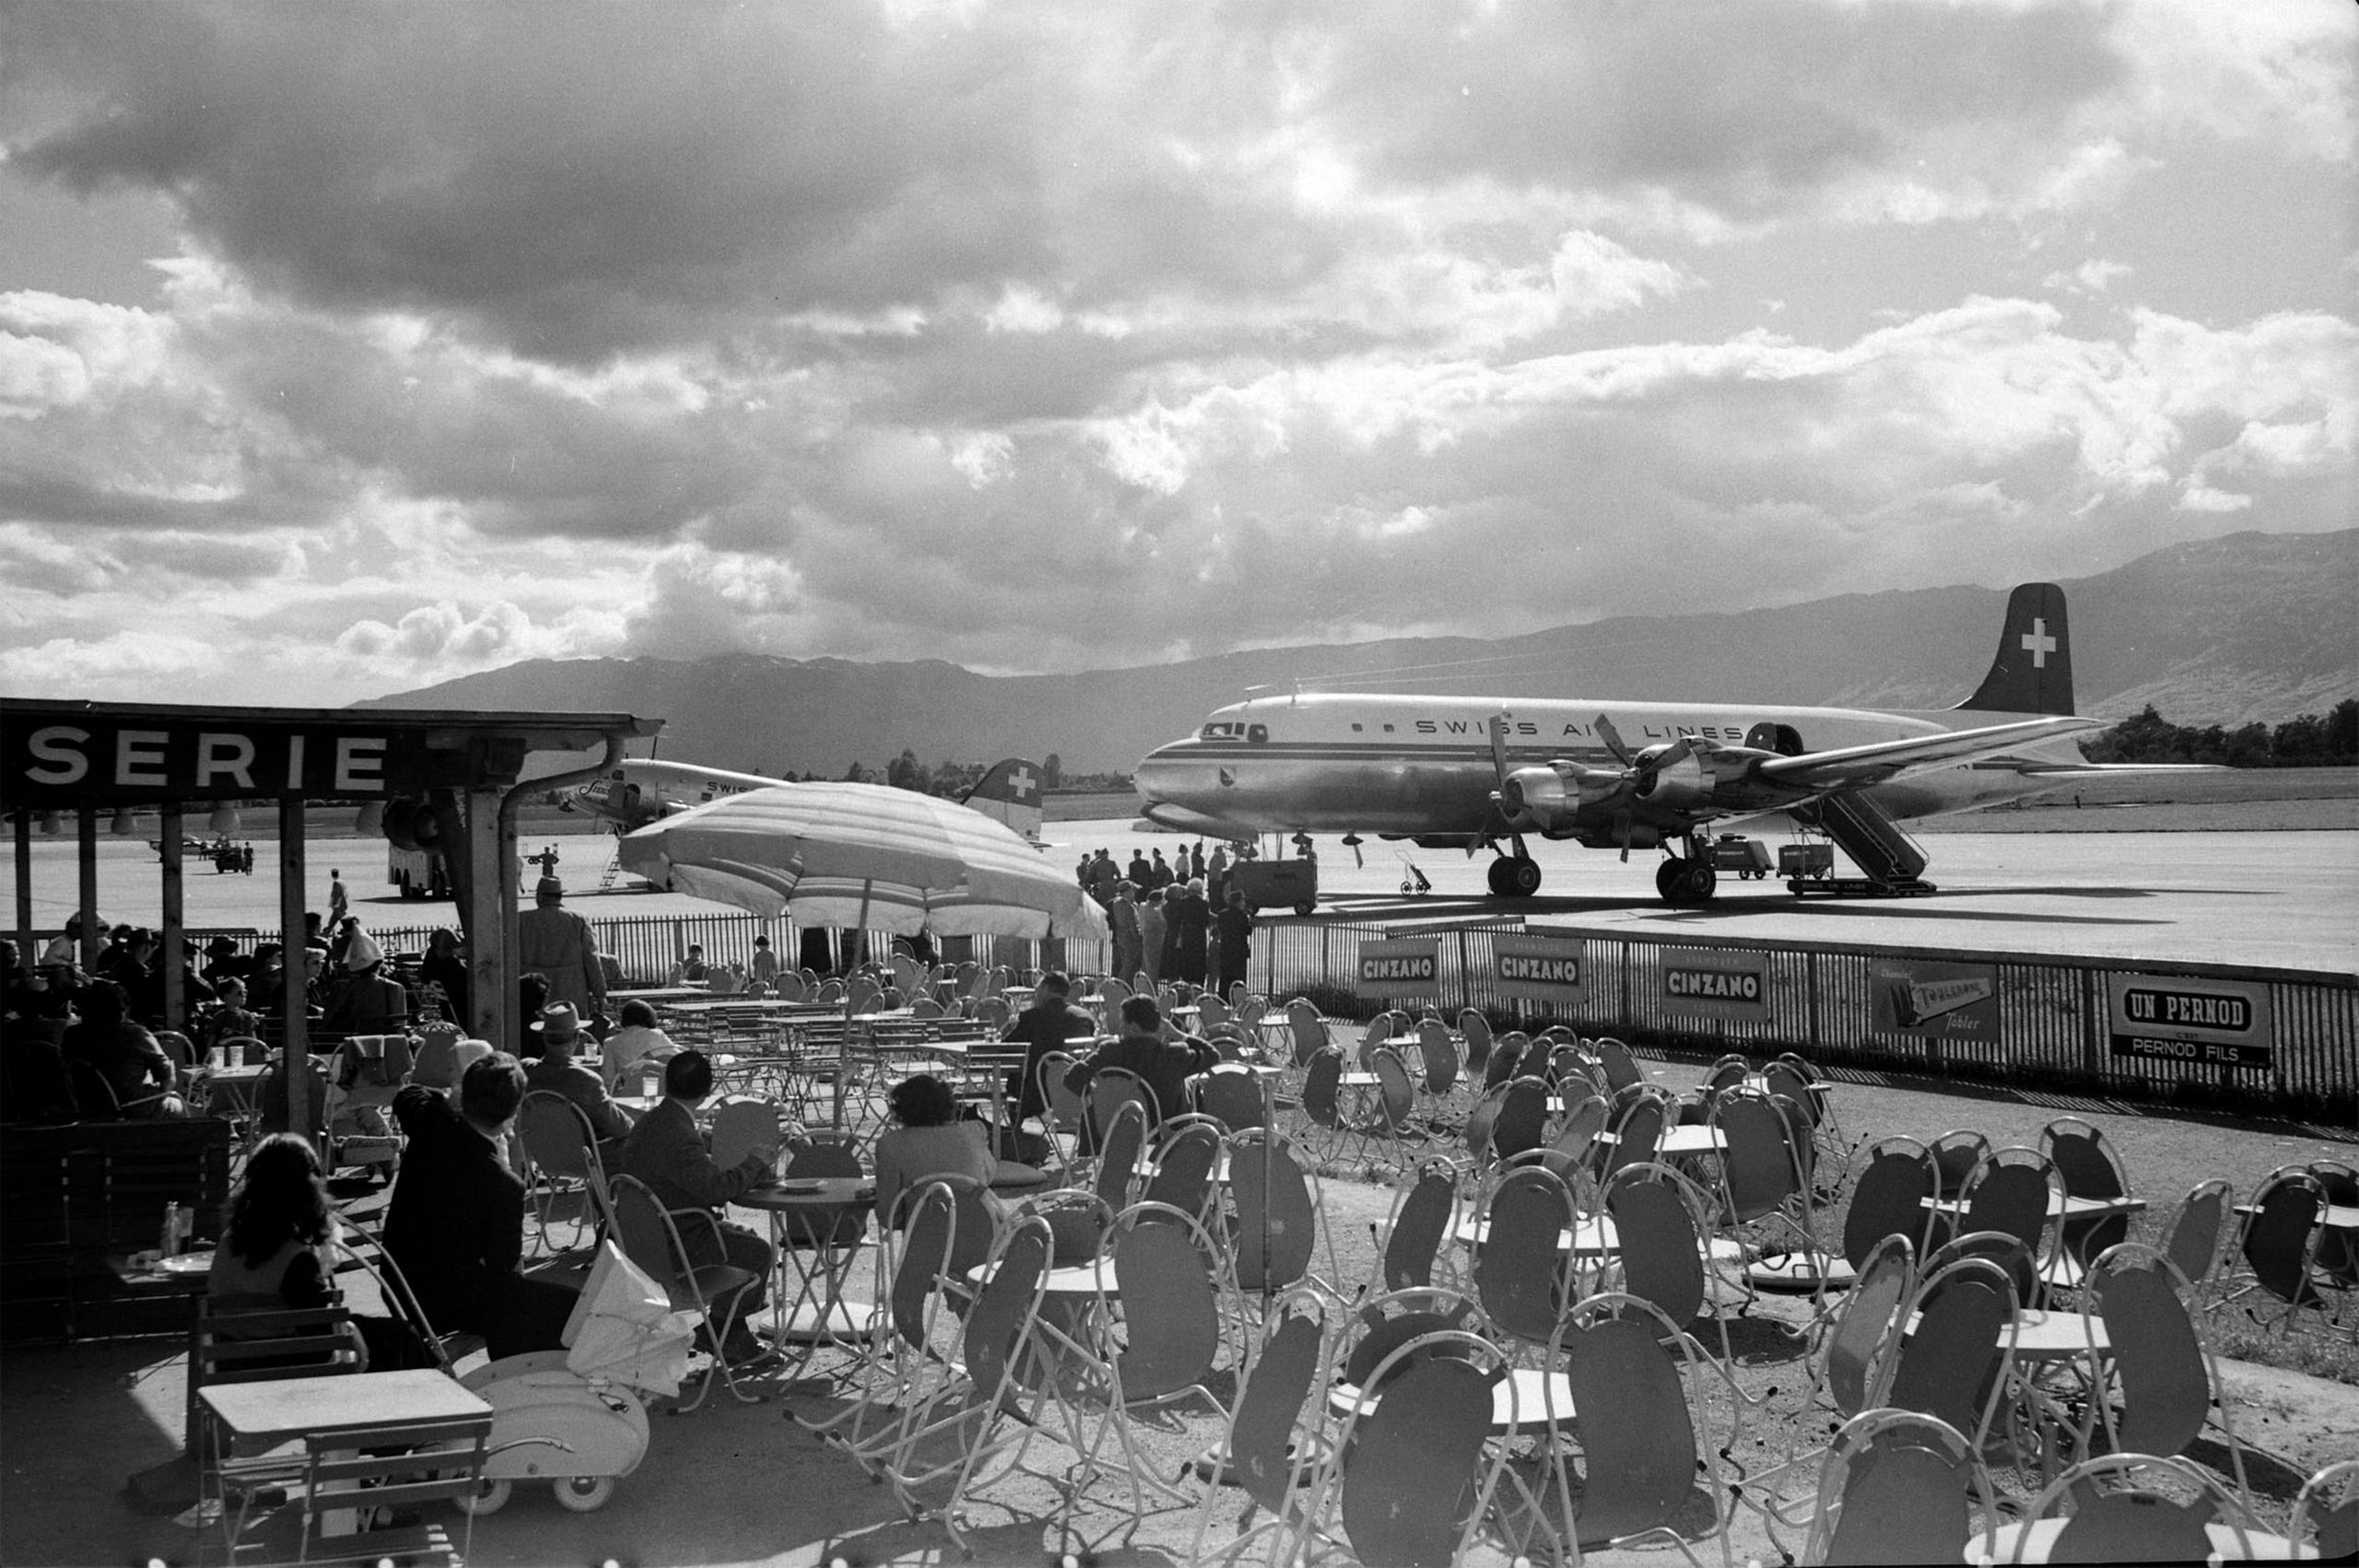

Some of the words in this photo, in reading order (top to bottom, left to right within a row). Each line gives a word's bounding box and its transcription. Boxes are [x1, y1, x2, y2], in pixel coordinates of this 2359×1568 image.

[1644, 724, 1743, 740] LINES
[24, 725, 388, 791] SERIE
[1363, 958, 1432, 978] CINZANO
[1501, 956, 1577, 981] CINZANO
[1668, 971, 1757, 999] CINZANO
[2130, 993, 2155, 1019] UN
[2165, 996, 2244, 1026] PERNOD
[1945, 1012, 1980, 1032] Tobler
[2132, 1039, 2197, 1058] PERNOD
[2206, 1045, 2239, 1062] FILS
